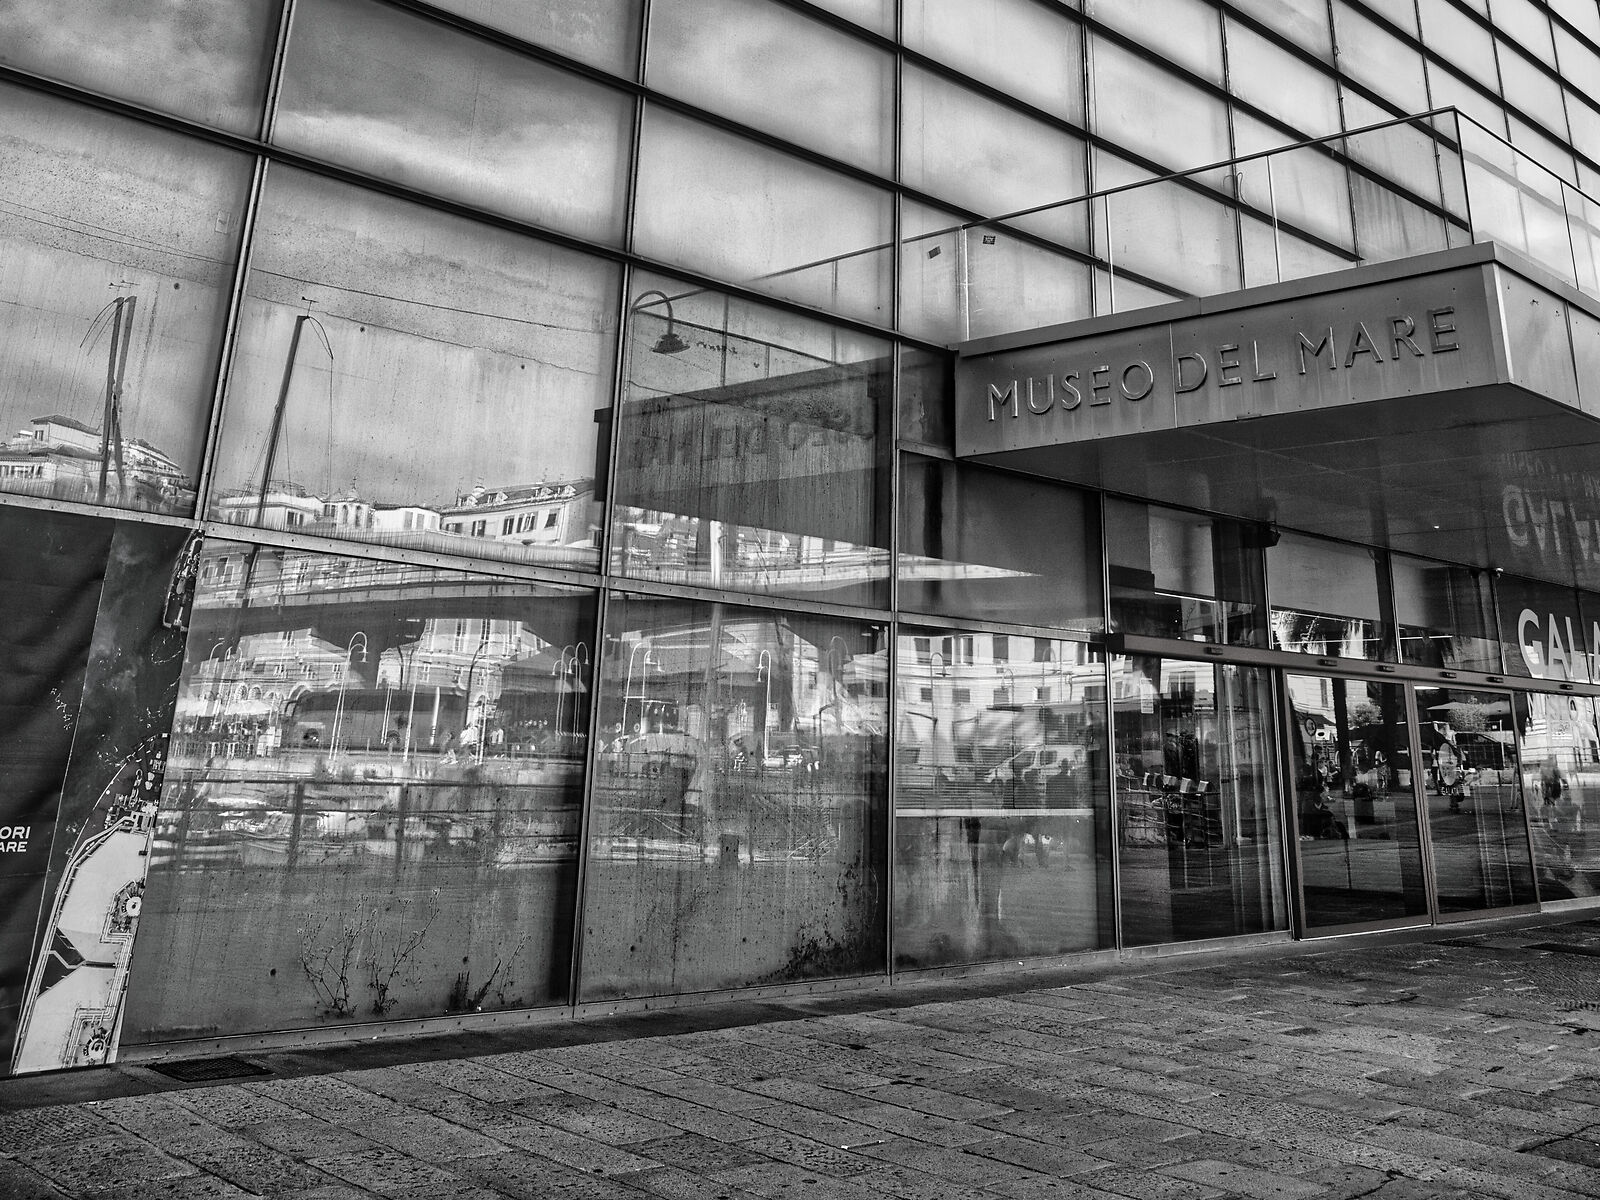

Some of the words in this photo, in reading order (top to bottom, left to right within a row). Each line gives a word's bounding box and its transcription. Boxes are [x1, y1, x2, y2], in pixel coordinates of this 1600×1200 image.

[986, 360, 1154, 422] MUSEO
[1175, 340, 1277, 393] DEL
[1296, 306, 1460, 375] MARE
